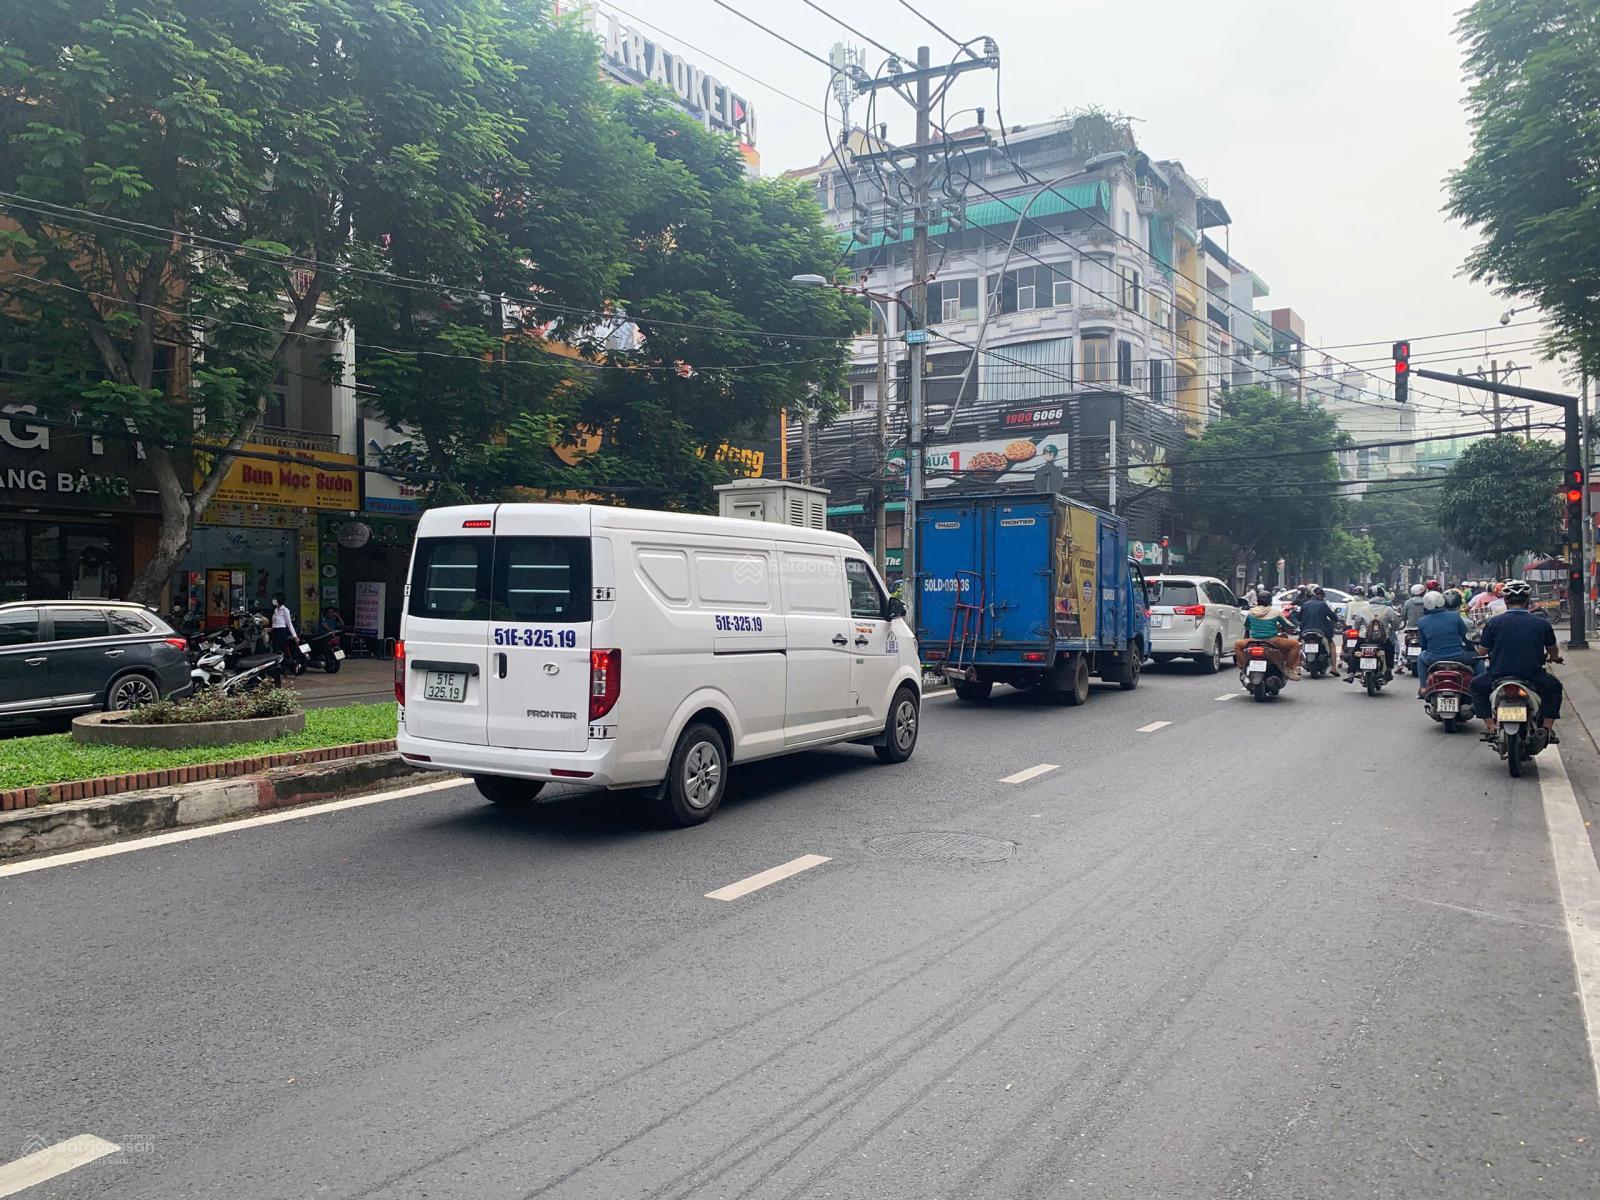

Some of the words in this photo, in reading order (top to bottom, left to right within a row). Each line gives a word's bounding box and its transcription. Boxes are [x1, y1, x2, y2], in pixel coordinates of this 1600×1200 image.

[0, 468, 47, 491] NG
[1001, 518, 1034, 526] FRONTIER
[885, 557, 901, 567] The
[924, 578, 970, 592] 50LD-03936
[715, 614, 763, 632] 51E-325.19
[494, 627, 577, 648] 51E-325.19
[437, 673, 455, 686] 51E
[428, 686, 460, 699] 325.19
[526, 709, 578, 720] FRONTIER
